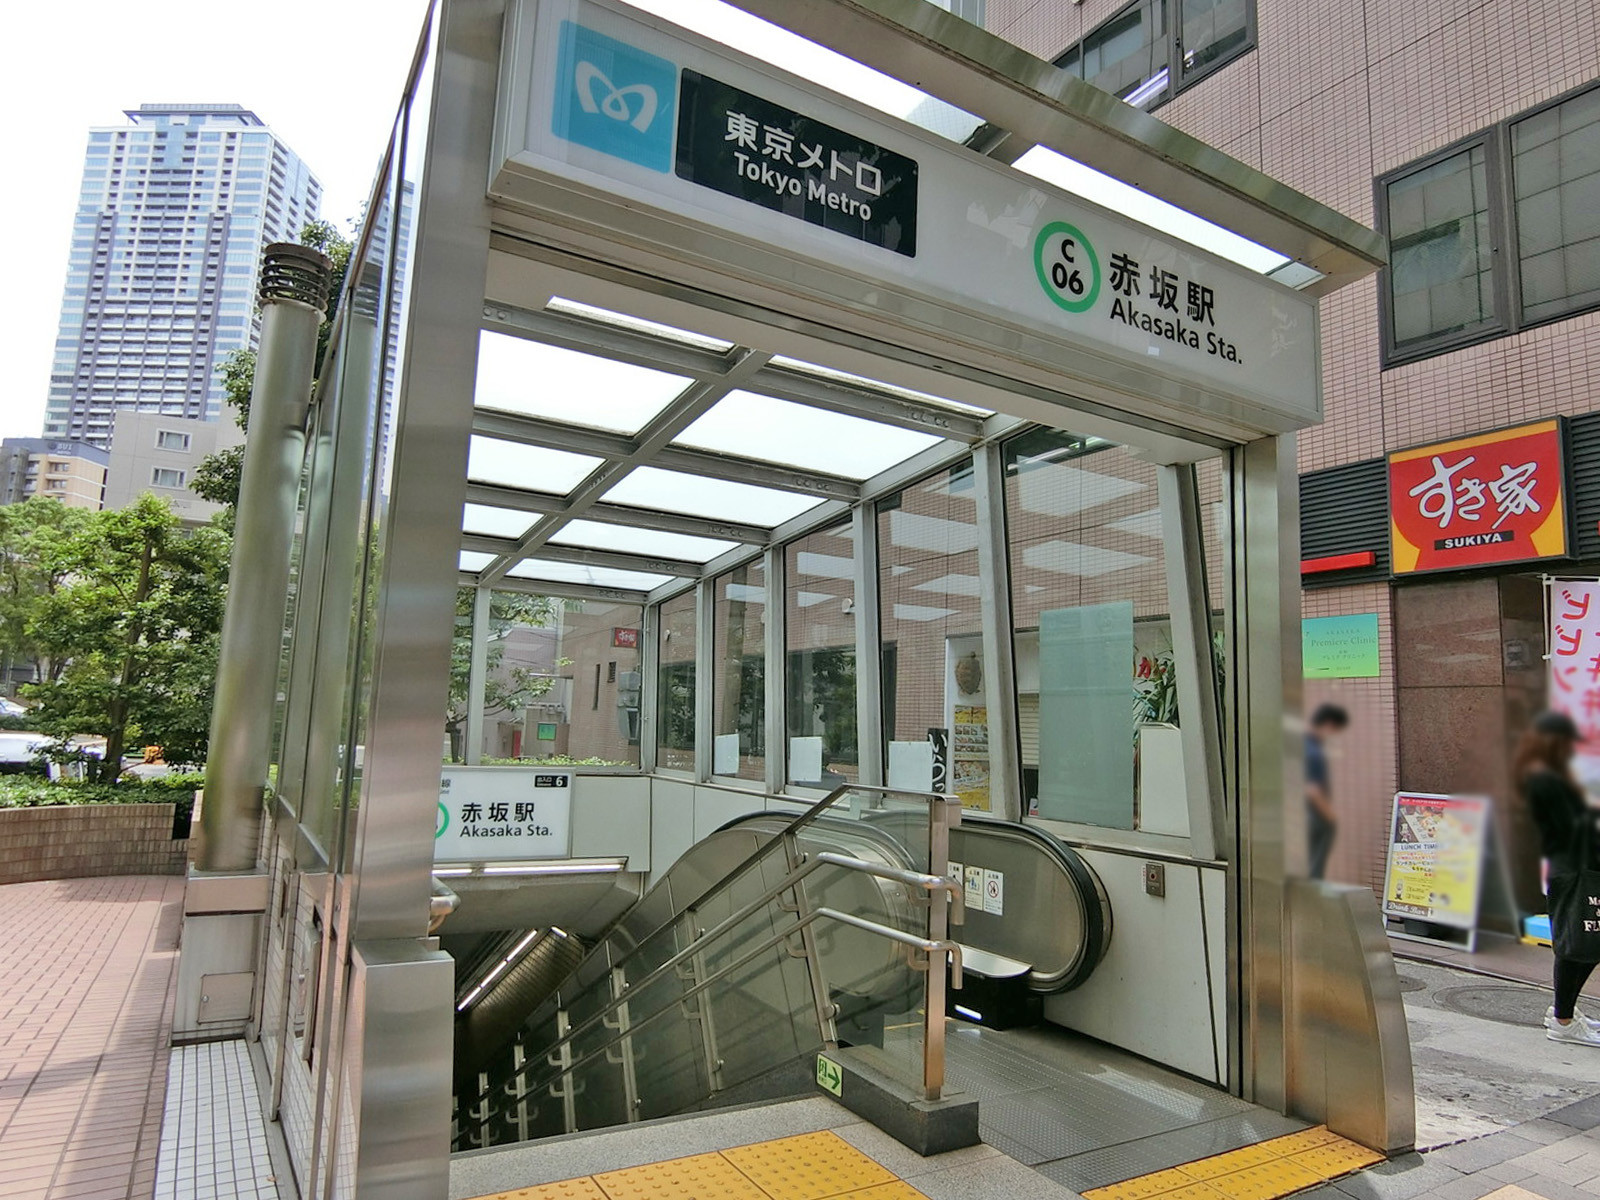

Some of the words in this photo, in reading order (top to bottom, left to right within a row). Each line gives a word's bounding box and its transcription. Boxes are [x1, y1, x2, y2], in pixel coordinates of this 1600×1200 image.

[725, 110, 882, 196] 東京メトロ
[733, 151, 802, 195] Tokyo
[808, 179, 872, 221] Metro
[1061, 239, 1075, 263] C
[1052, 262, 1084, 295] 06
[1109, 252, 1215, 327] 赤坂駅
[1110, 298, 1200, 350] Akasaka
[1207, 331, 1243, 364] Sta.
[1408, 456, 1541, 530] すき家
[1444, 533, 1503, 549] SUKIYA
[1311, 639, 1348, 647] Premiere
[1351, 636, 1376, 645] Clinic
[555, 776, 563, 787] 6
[461, 802, 535, 823] 赤坂駅
[460, 825, 522, 838] Akasaka
[527, 824, 553, 837] Sta.
[1388, 902, 1410, 913] Drink
